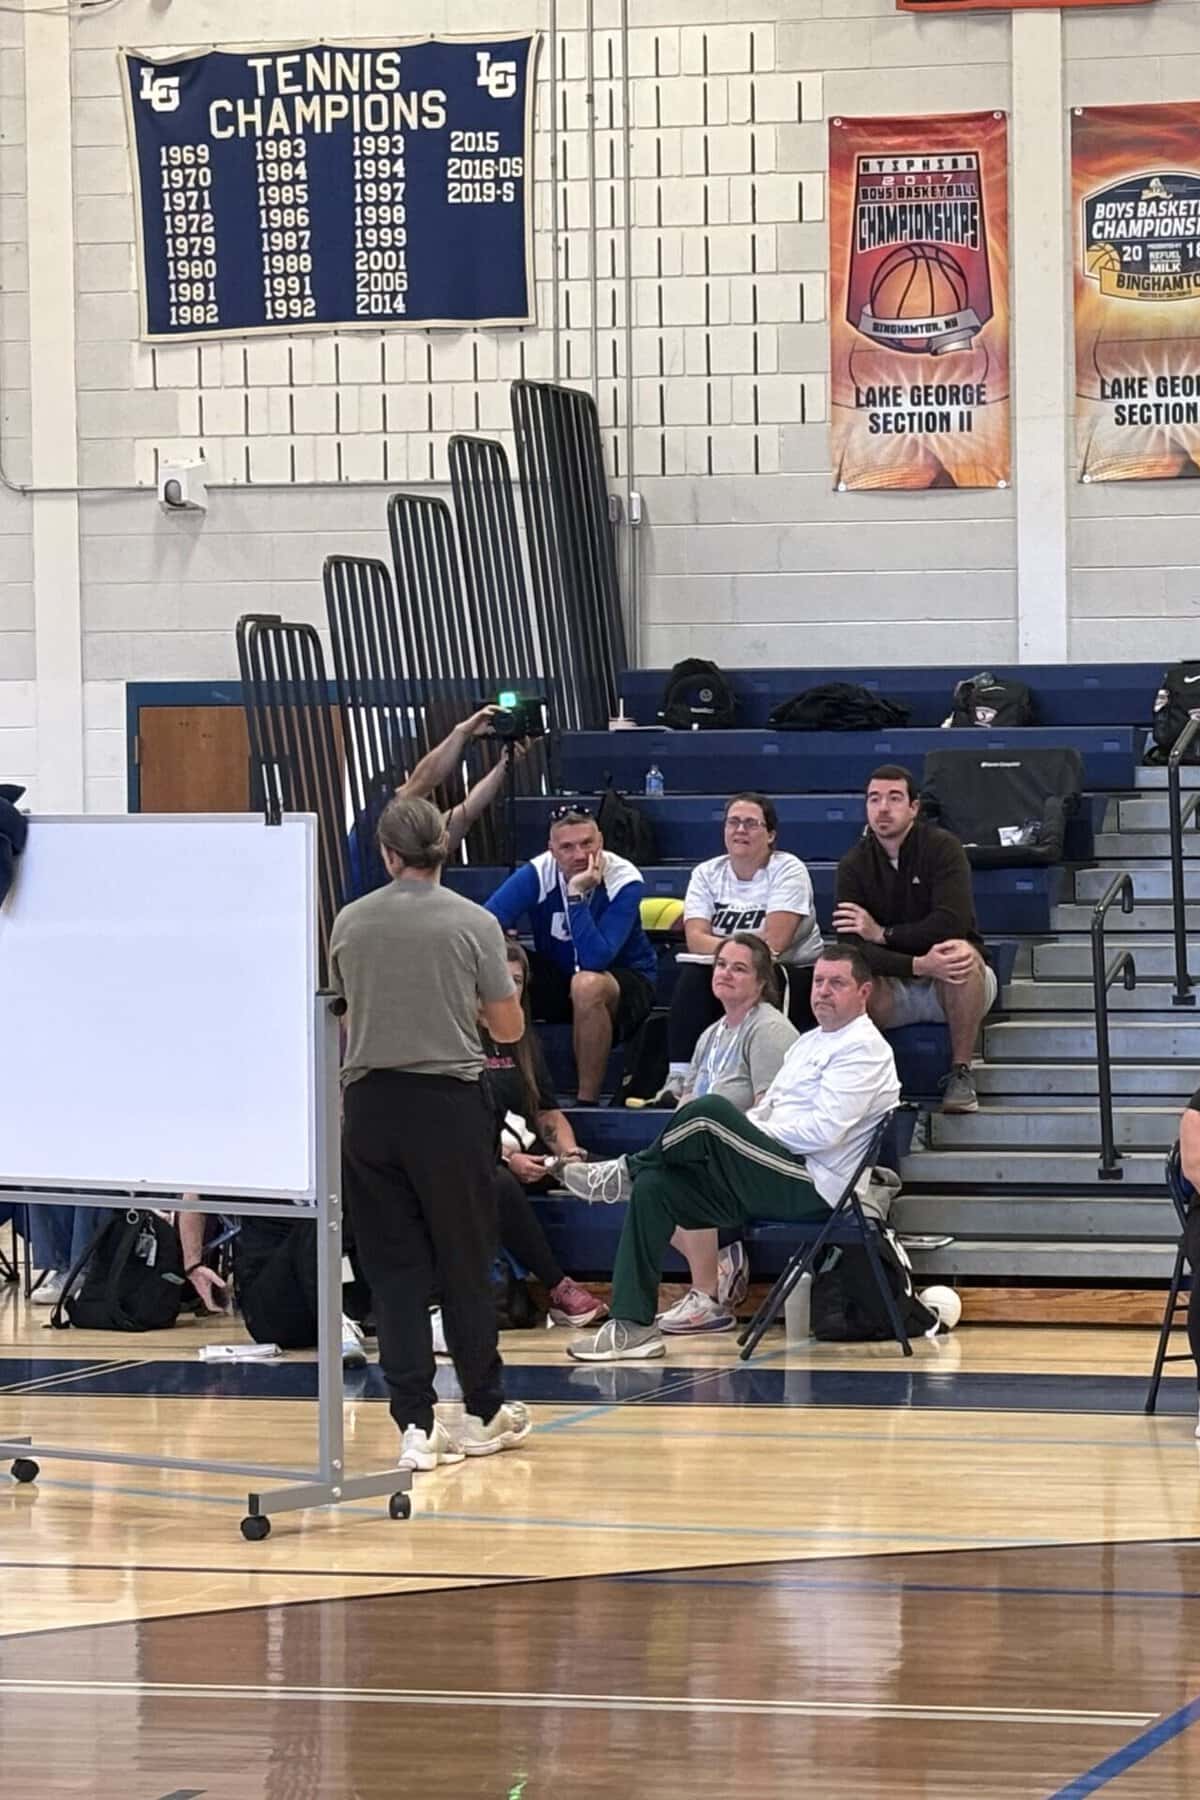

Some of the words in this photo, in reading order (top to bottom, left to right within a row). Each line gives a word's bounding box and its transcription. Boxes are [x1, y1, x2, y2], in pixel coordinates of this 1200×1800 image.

[248, 51, 401, 96] TENNIS
[209, 90, 447, 139] CHAMPIONS
[255, 139, 306, 159] 1983
[353, 135, 405, 155] 1993
[450, 131, 499, 153] 2015
[160, 144, 210, 166] 1969
[161, 167, 211, 189] 1970
[257, 159, 308, 182] 1984
[354, 159, 405, 179] 1994
[882, 174, 953, 186] 2017
[163, 191, 211, 212] 1971
[258, 184, 308, 205] 1985
[354, 182, 406, 202] 1997
[861, 186, 892, 200] BOYS
[897, 183, 977, 199] BASKETBALL
[260, 209, 309, 228] 1986
[355, 206, 406, 225] 1998
[1095, 201, 1134, 220] BOYS
[165, 214, 215, 235] 1972
[858, 200, 979, 253] CHAMPIONSHIPS
[166, 237, 216, 256] 1979
[262, 231, 311, 252] 1987
[355, 228, 407, 248] 1999
[355, 251, 406, 271] 2001
[1122, 246, 1142, 261] 20
[168, 260, 216, 280] 1980
[263, 255, 312, 275] 1988
[1150, 263, 1181, 272] MILK
[169, 282, 216, 302] 1981
[264, 277, 311, 297] 1991
[356, 272, 408, 292] 2006
[265, 299, 316, 320] 1992
[356, 294, 406, 314] 2014
[170, 305, 219, 325] 1982
[855, 386, 902, 408] LAKE
[910, 383, 987, 406] GEORGE
[1100, 377, 1147, 399] LAKE
[869, 411, 950, 434] SECTION
[959, 411, 972, 432] II
[1115, 402, 1198, 426] SECTION
